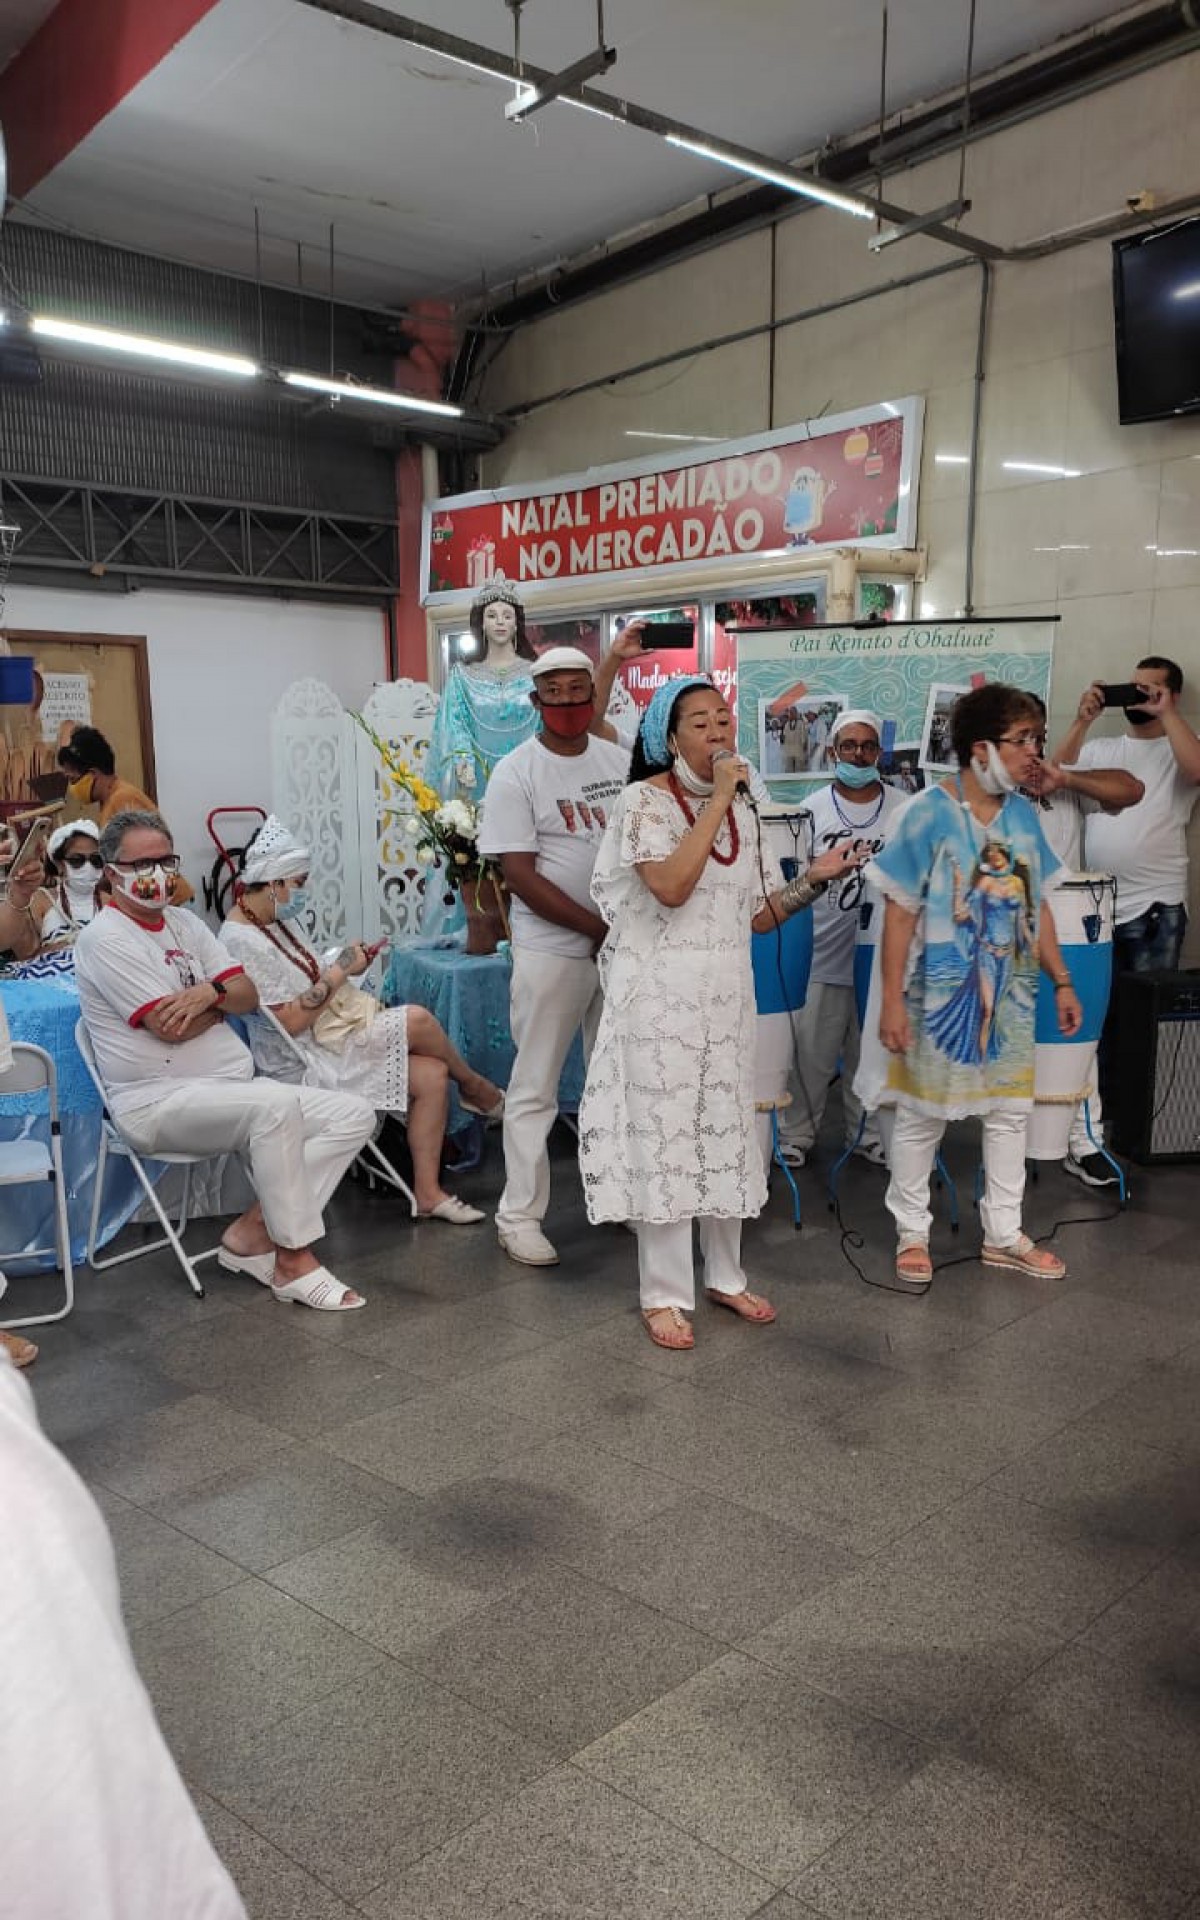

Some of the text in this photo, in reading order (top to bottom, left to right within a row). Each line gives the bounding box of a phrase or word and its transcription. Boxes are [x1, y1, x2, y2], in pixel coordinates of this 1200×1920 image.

[502, 451, 782, 539] NATAL PREMIADO
[519, 502, 764, 581] NO MERCADÃO
[789, 634, 821, 652] Pai
[827, 631, 893, 654] Renato
